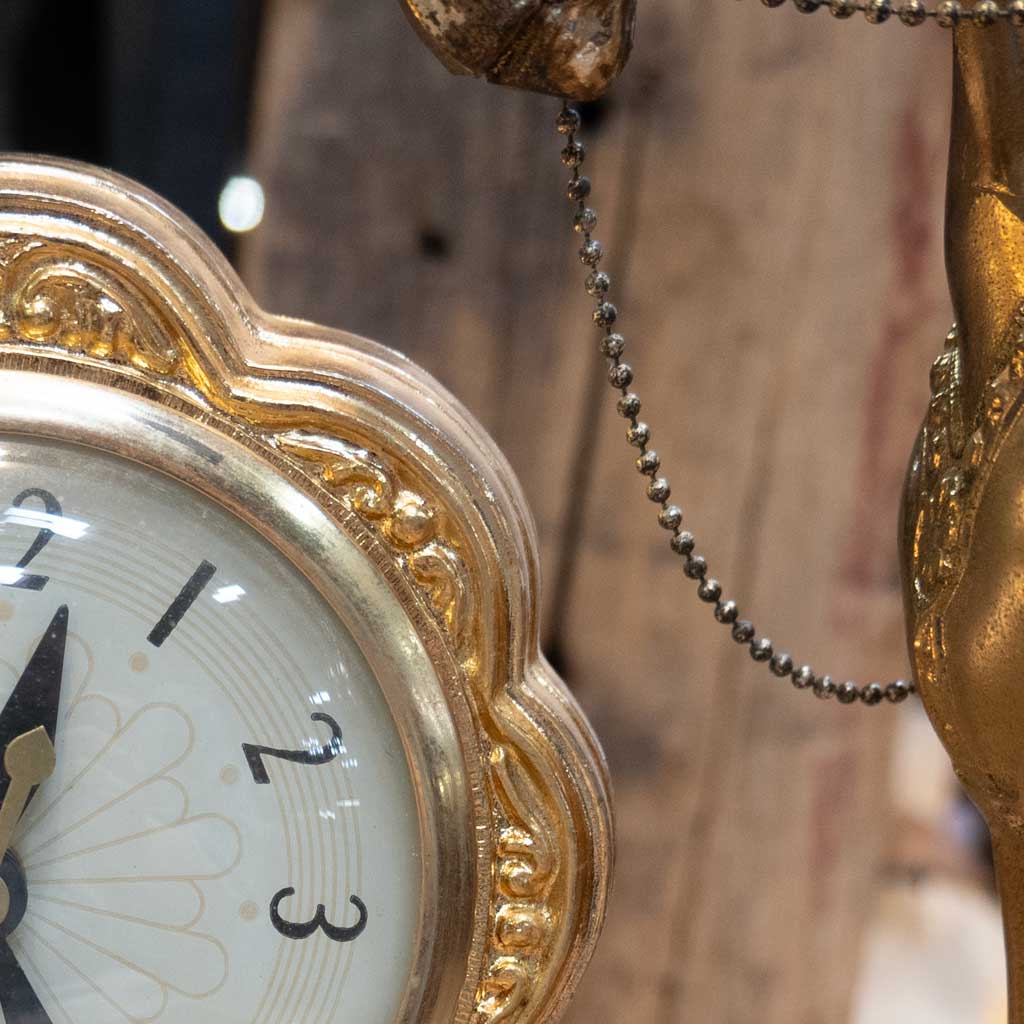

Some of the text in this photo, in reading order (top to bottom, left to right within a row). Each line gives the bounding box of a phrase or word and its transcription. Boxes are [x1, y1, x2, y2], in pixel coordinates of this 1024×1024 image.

[146, 559, 218, 648] 1
[241, 712, 344, 785] 2
[269, 886, 369, 943] 3
